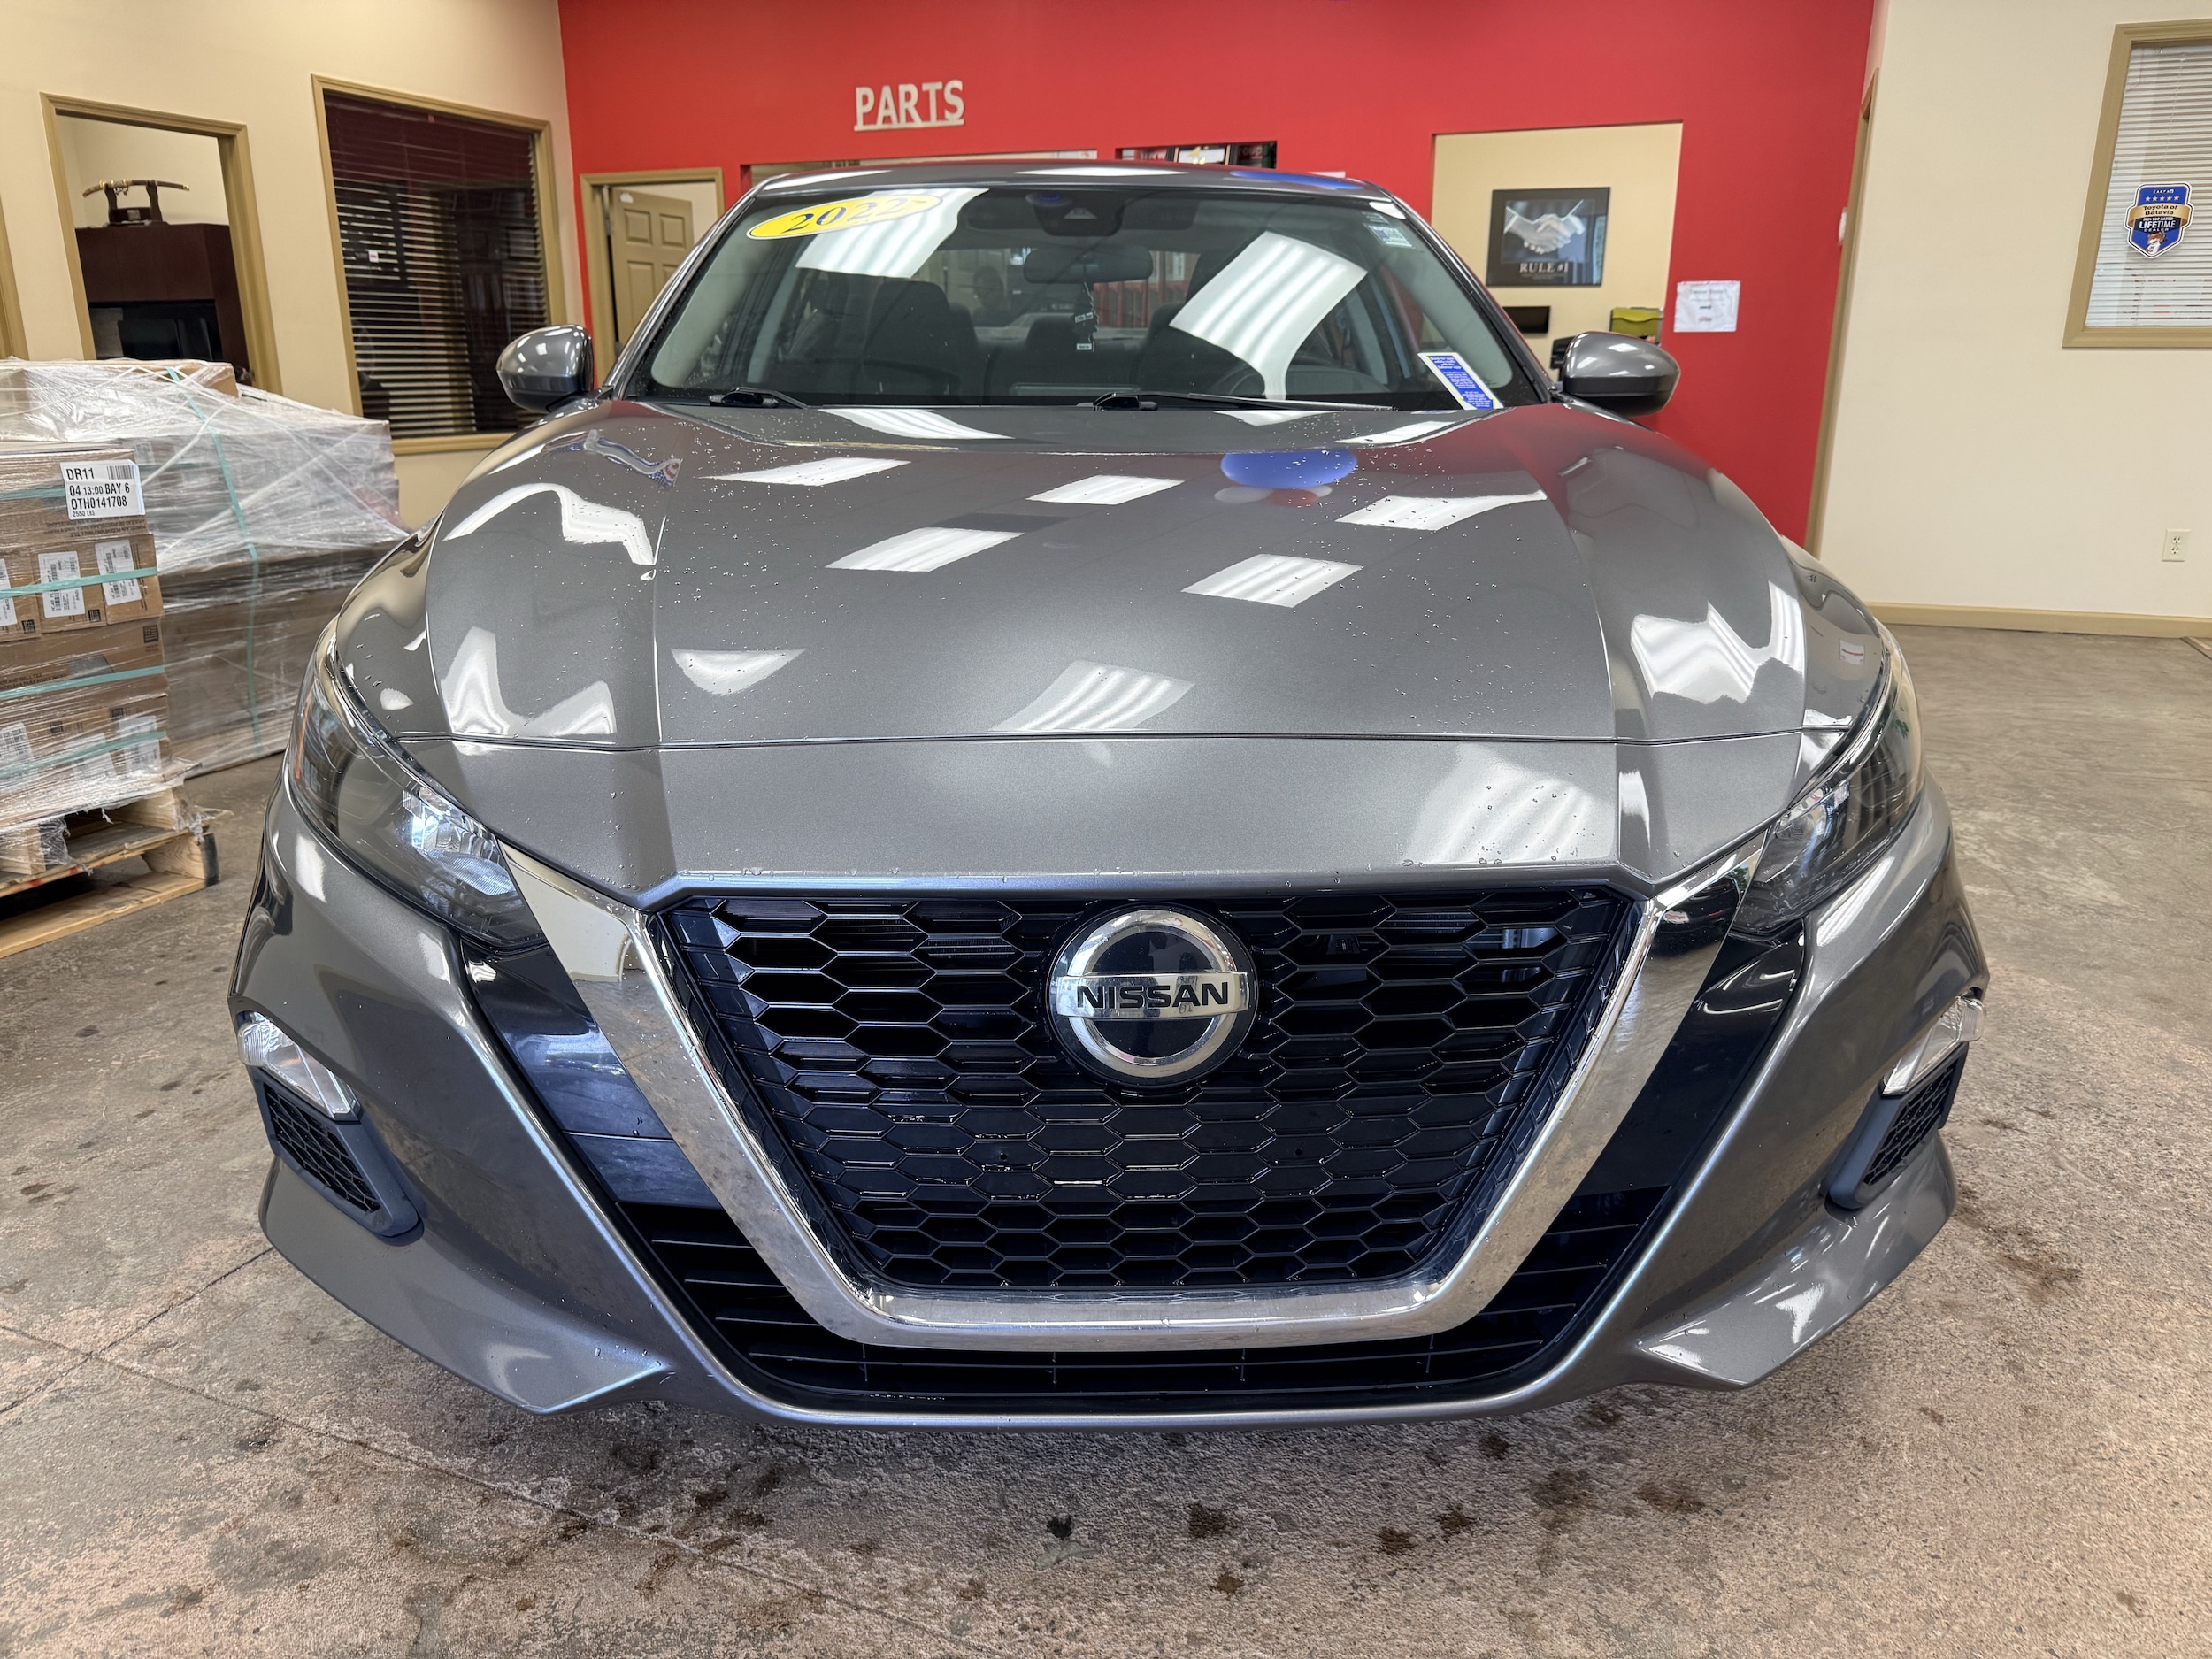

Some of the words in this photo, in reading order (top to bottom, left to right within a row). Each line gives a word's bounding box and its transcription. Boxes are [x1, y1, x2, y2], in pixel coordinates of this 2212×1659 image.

[854, 80, 965, 130] PARTS
[781, 197, 908, 234] 2022
[1519, 263, 1555, 273] RULE
[1557, 262, 1569, 273] #1
[66, 467, 95, 480] DR11
[69, 485, 81, 496] 04
[83, 486, 104, 495] 13:00
[105, 483, 121, 495] BAY
[125, 482, 130, 494] 6
[1077, 982, 1229, 1009] NISSAN
